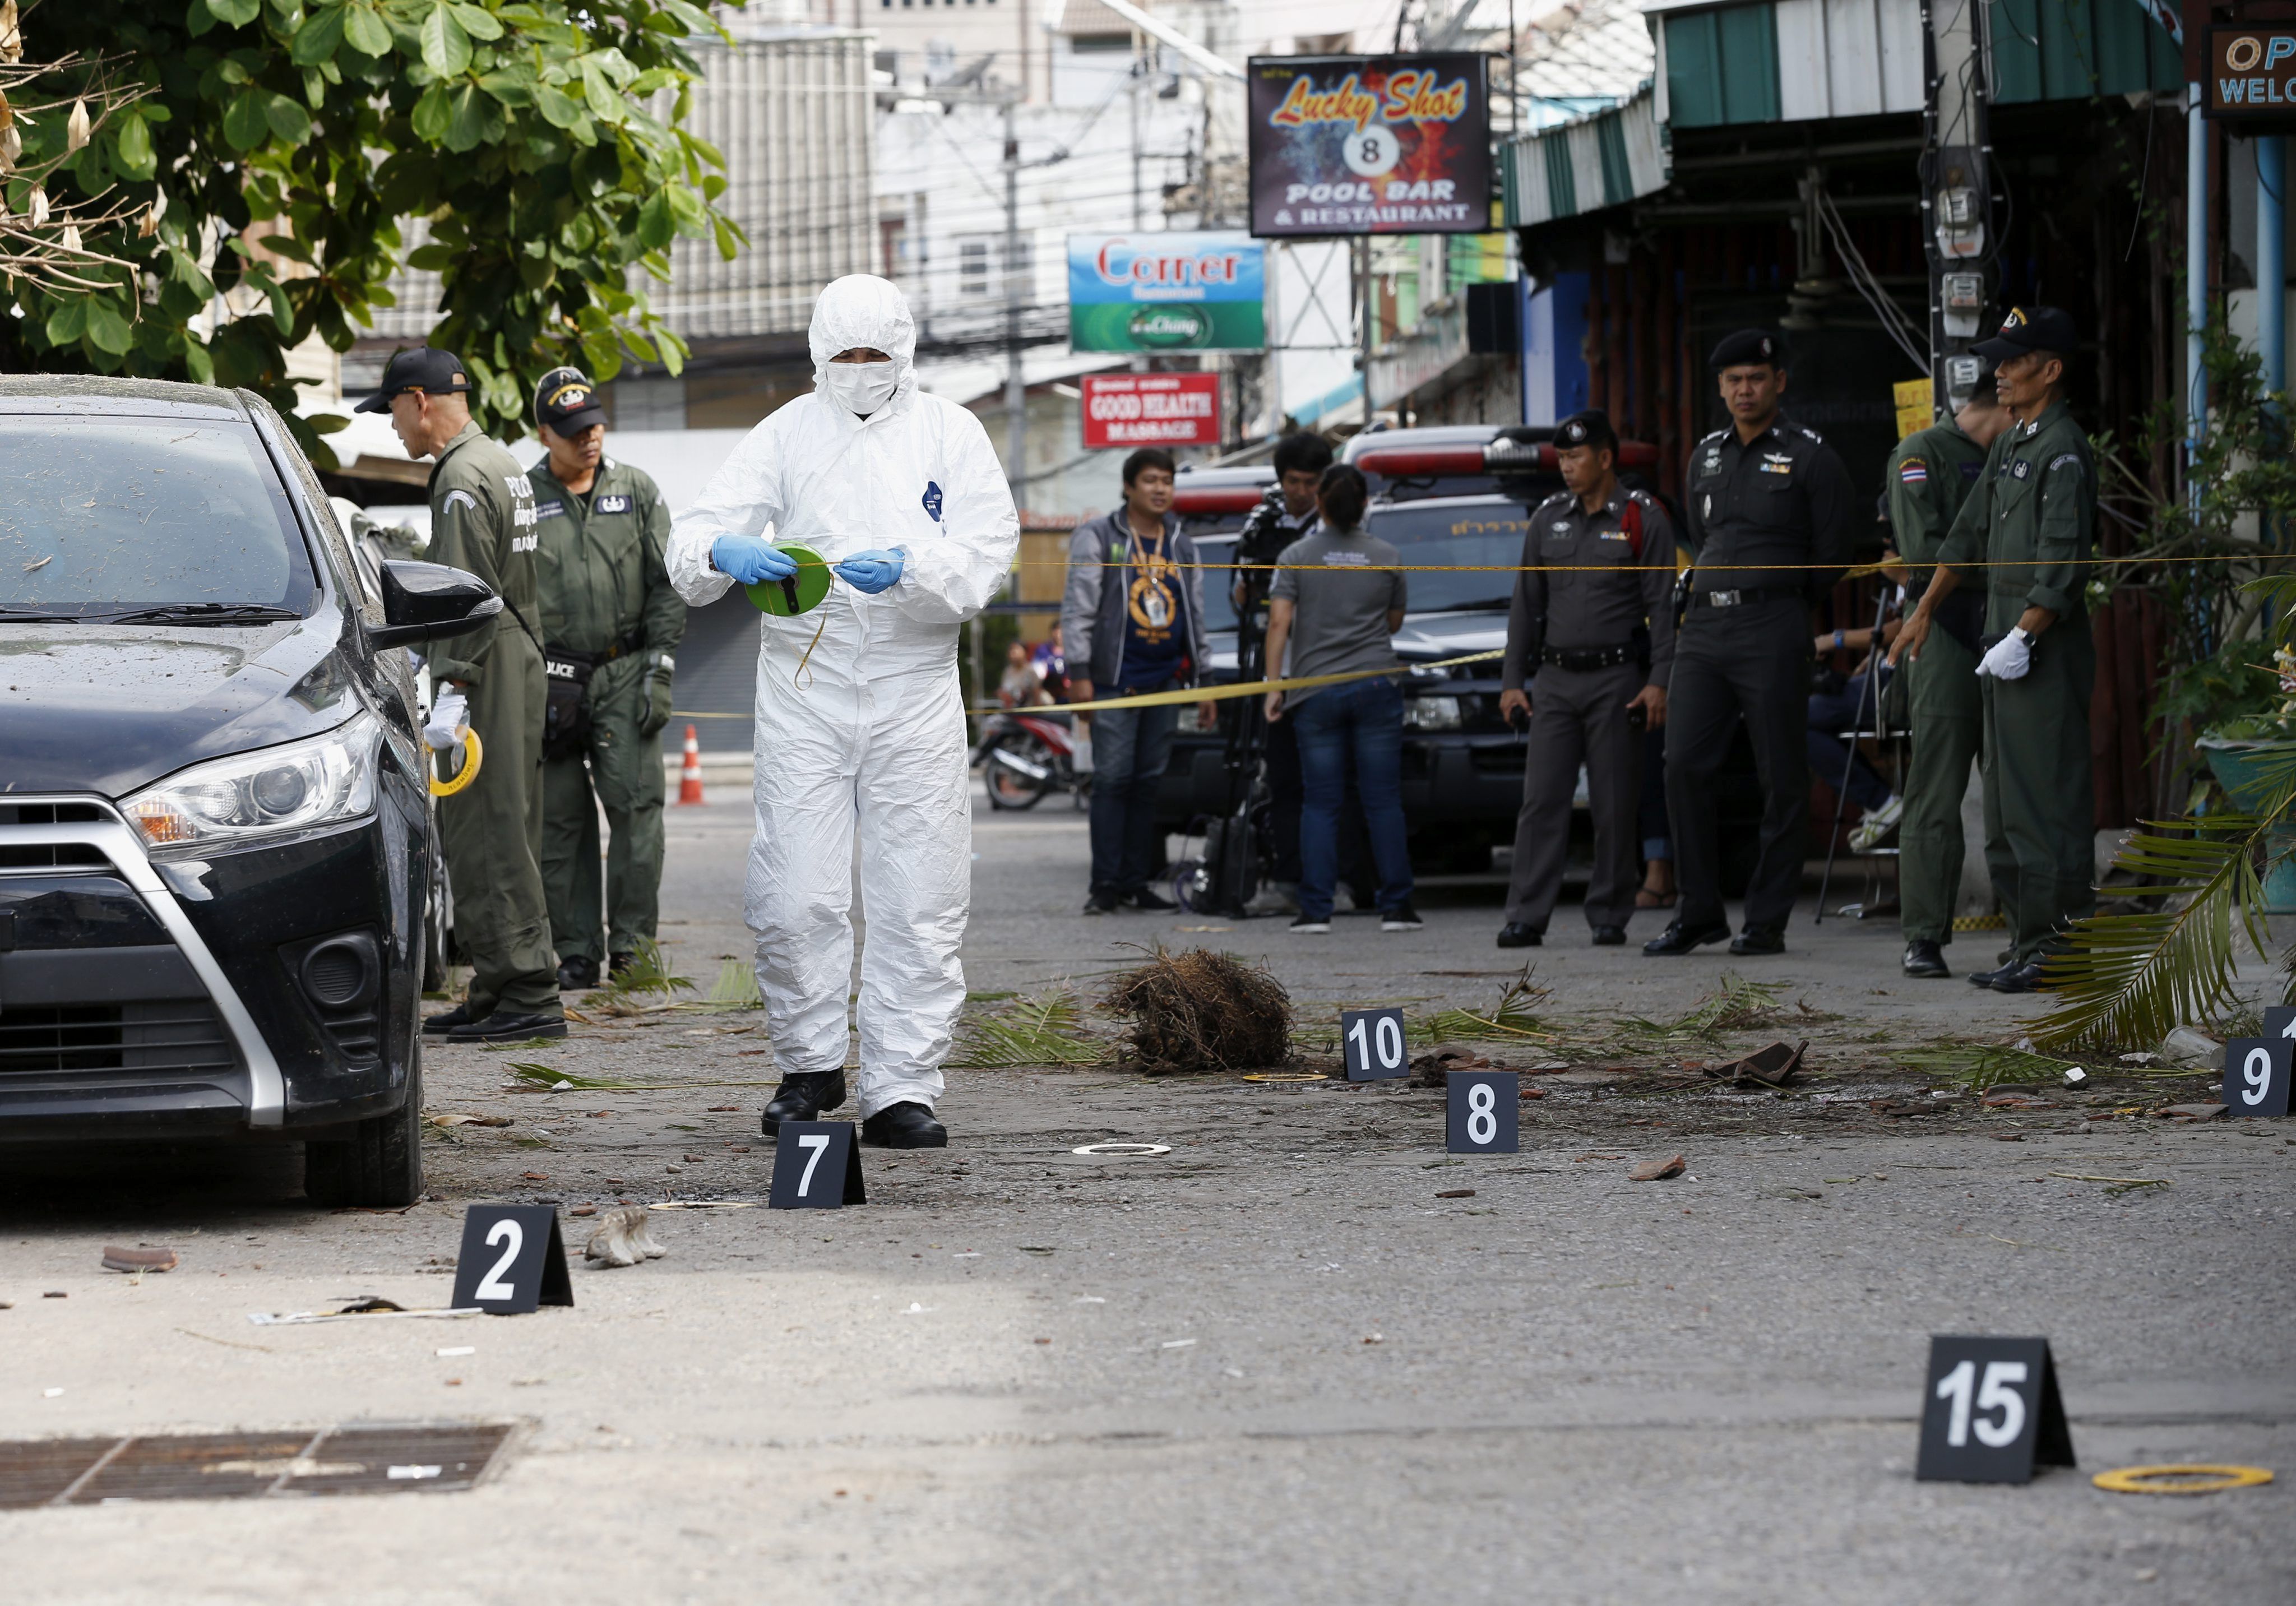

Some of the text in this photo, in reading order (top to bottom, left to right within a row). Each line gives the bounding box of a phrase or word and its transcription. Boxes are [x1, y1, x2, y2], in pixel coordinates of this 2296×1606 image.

[1272, 70, 1466, 133] Lucky Shot
[1361, 138, 1378, 163] 8
[1275, 204, 1469, 225] & RESTAURANT
[1286, 180, 1456, 204] POOL BAR
[1098, 238, 1241, 285] Corner
[1091, 393, 1212, 420] GOOD HEALTH
[1107, 421, 1197, 441] MASSAGE
[546, 661, 575, 678] OLICE
[1349, 1017, 1401, 1070] 10
[2242, 1048, 2271, 1105] 9
[1468, 1084, 1496, 1144] 8
[798, 1135, 830, 1196] 7
[475, 1219, 522, 1300] 2
[1937, 1362, 2026, 1446] 15
